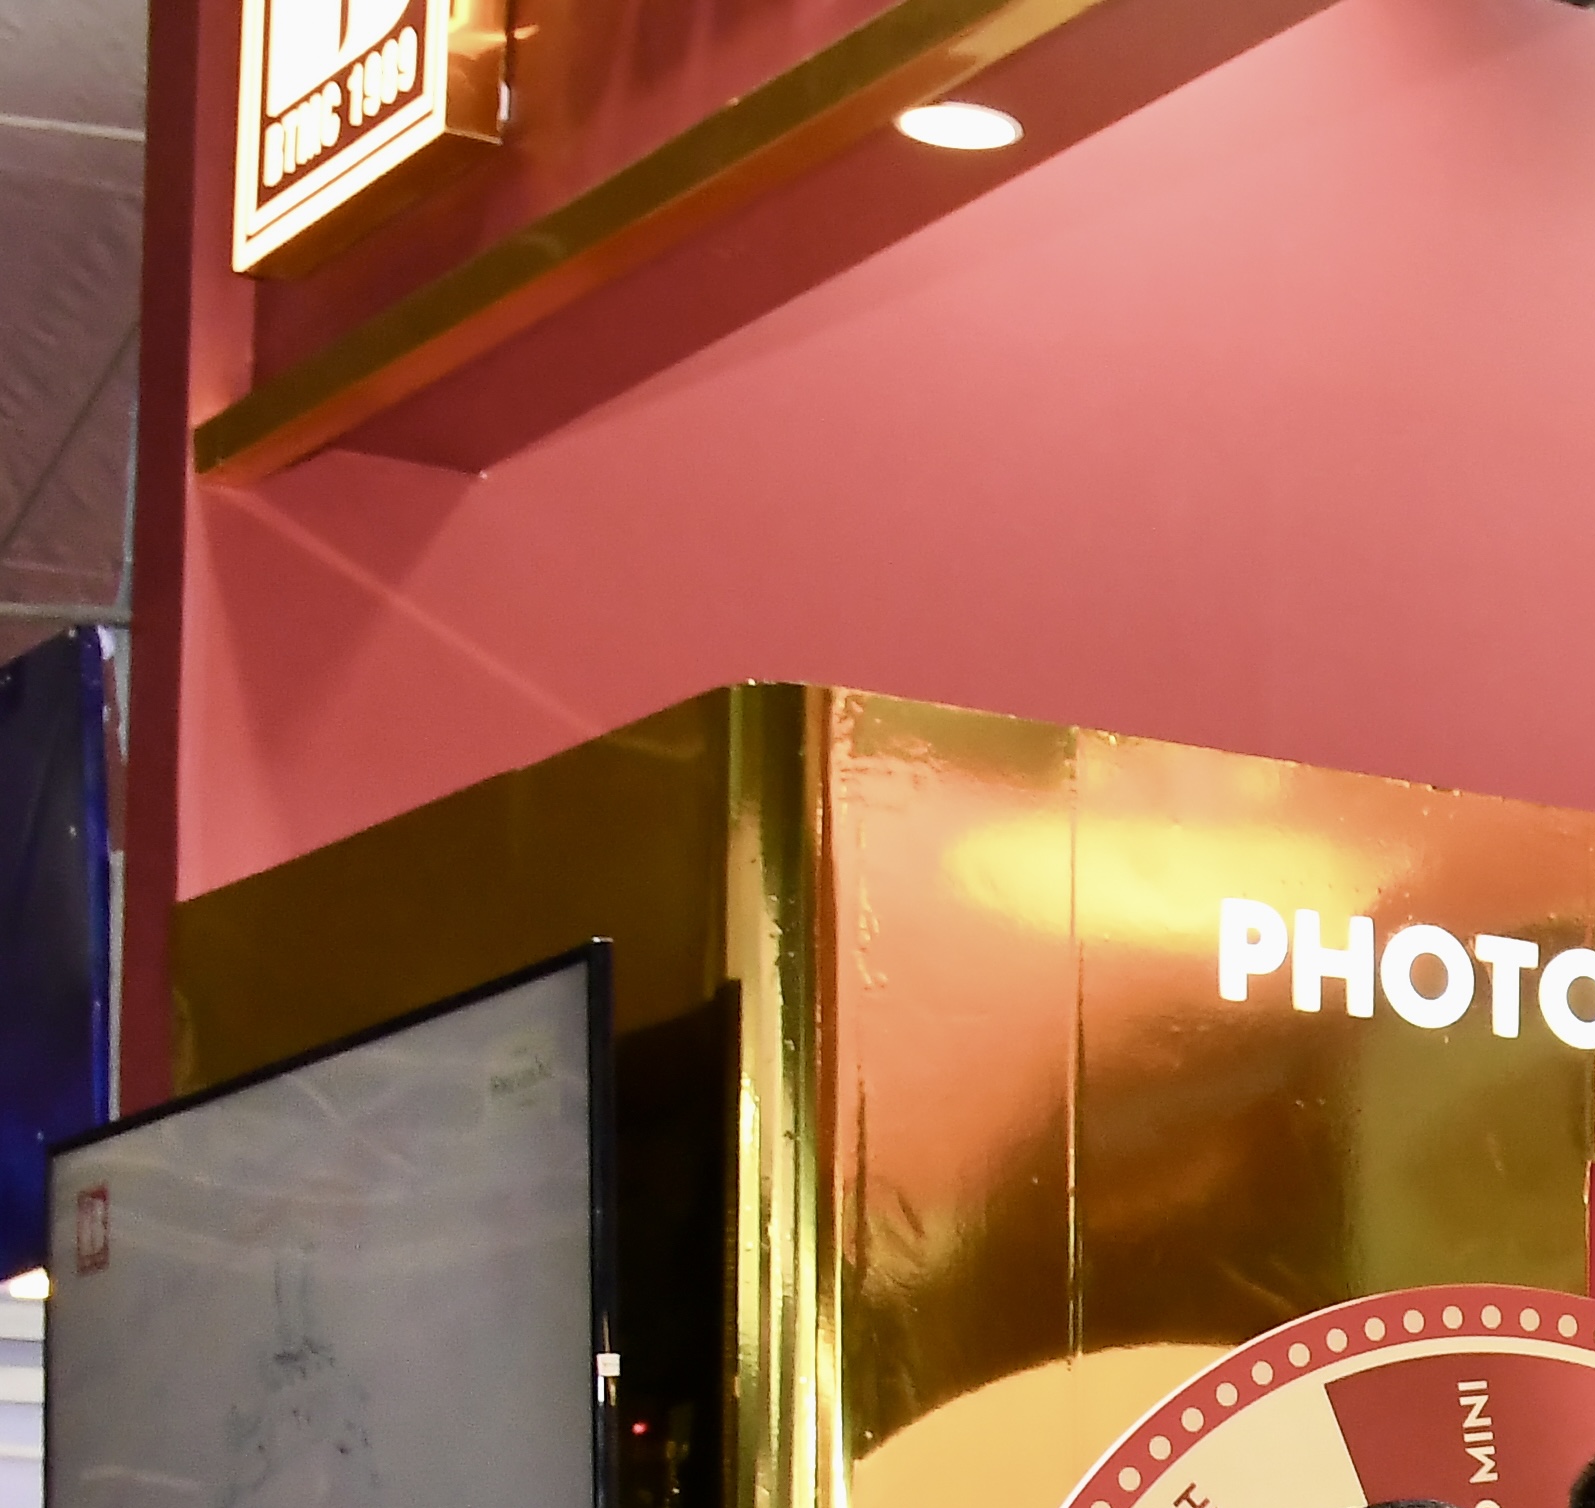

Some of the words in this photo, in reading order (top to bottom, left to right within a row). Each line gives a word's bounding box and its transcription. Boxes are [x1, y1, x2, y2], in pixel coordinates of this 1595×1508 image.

[263, 81, 342, 187] BTMC
[347, 26, 418, 126] 1989
[1457, 1378, 1500, 1484] MINI
